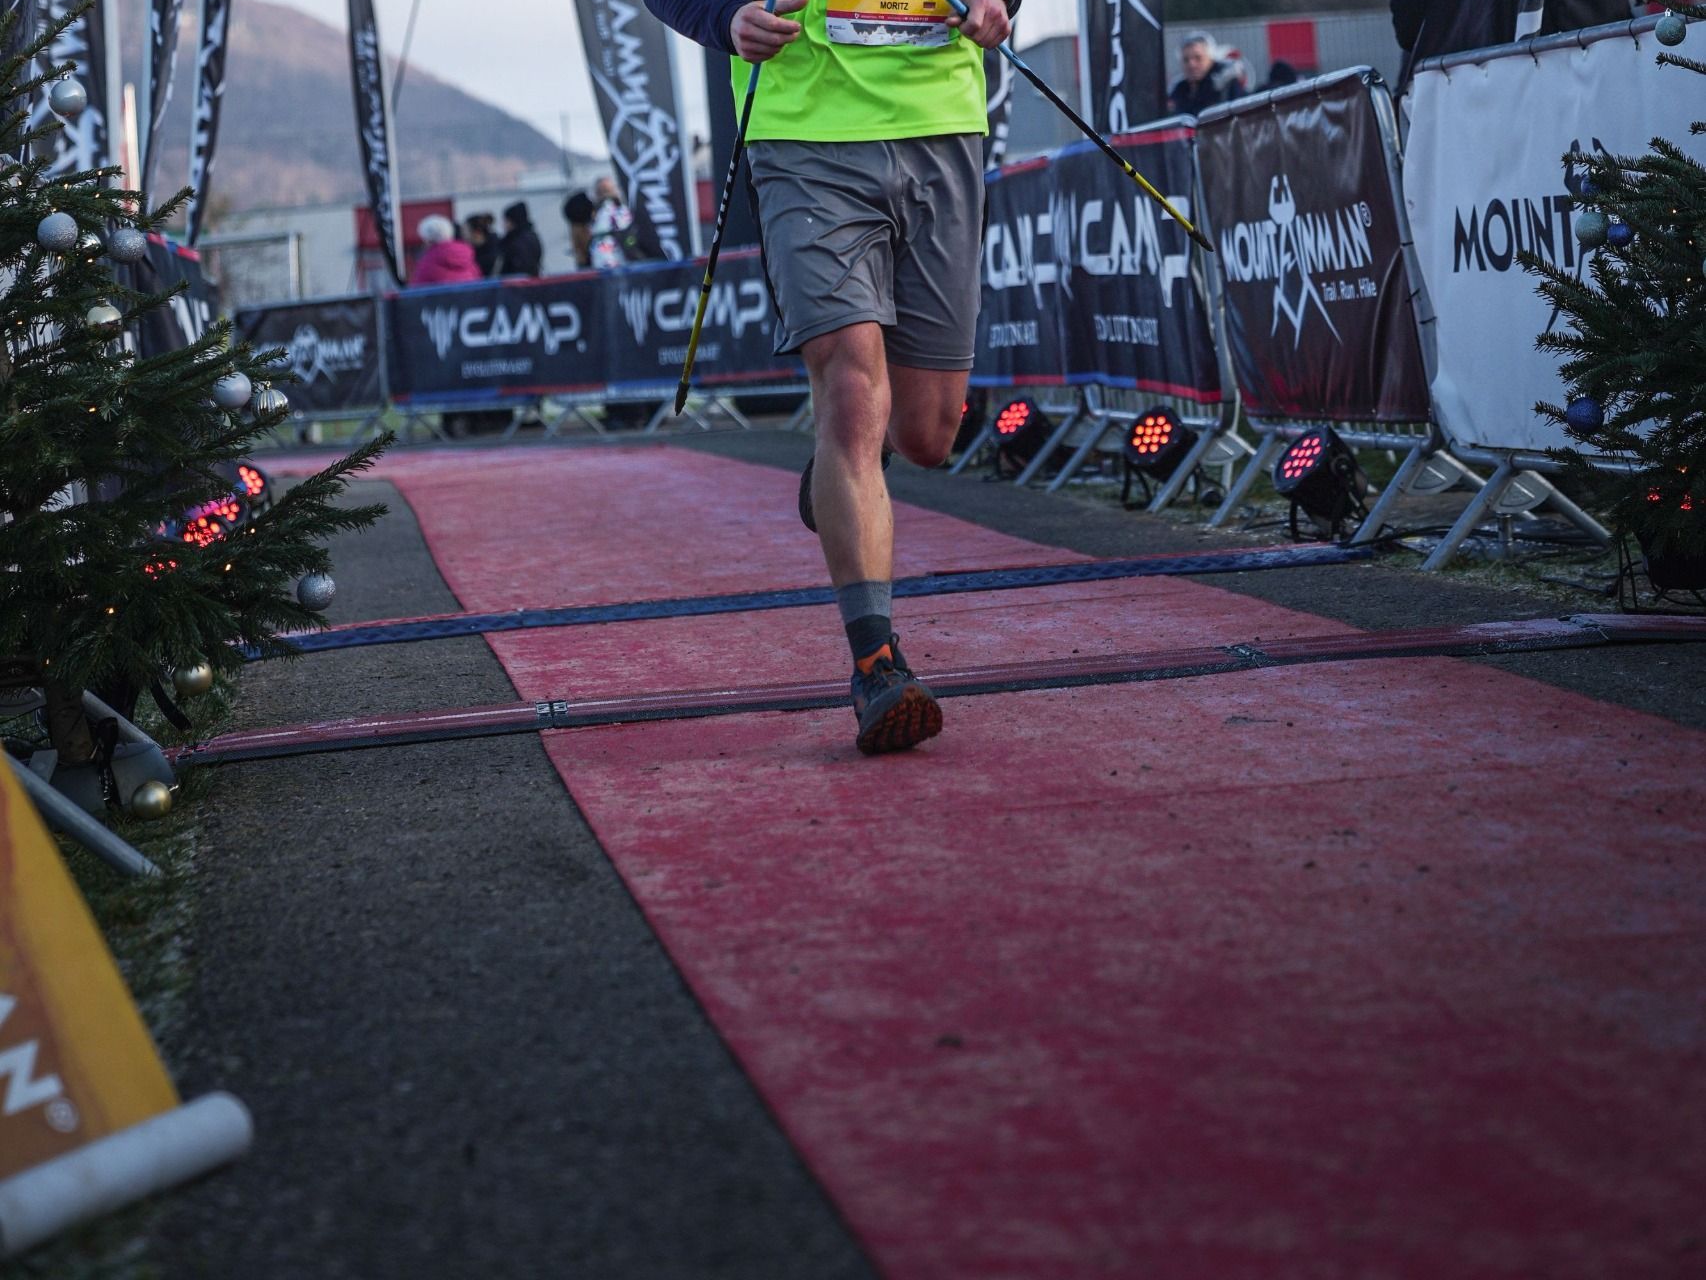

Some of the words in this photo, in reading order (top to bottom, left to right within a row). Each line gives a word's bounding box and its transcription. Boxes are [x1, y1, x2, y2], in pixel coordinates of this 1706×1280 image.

[880, 1, 909, 11] MORITZ
[459, 301, 582, 355] CAMP
[654, 278, 769, 340] CAMP
